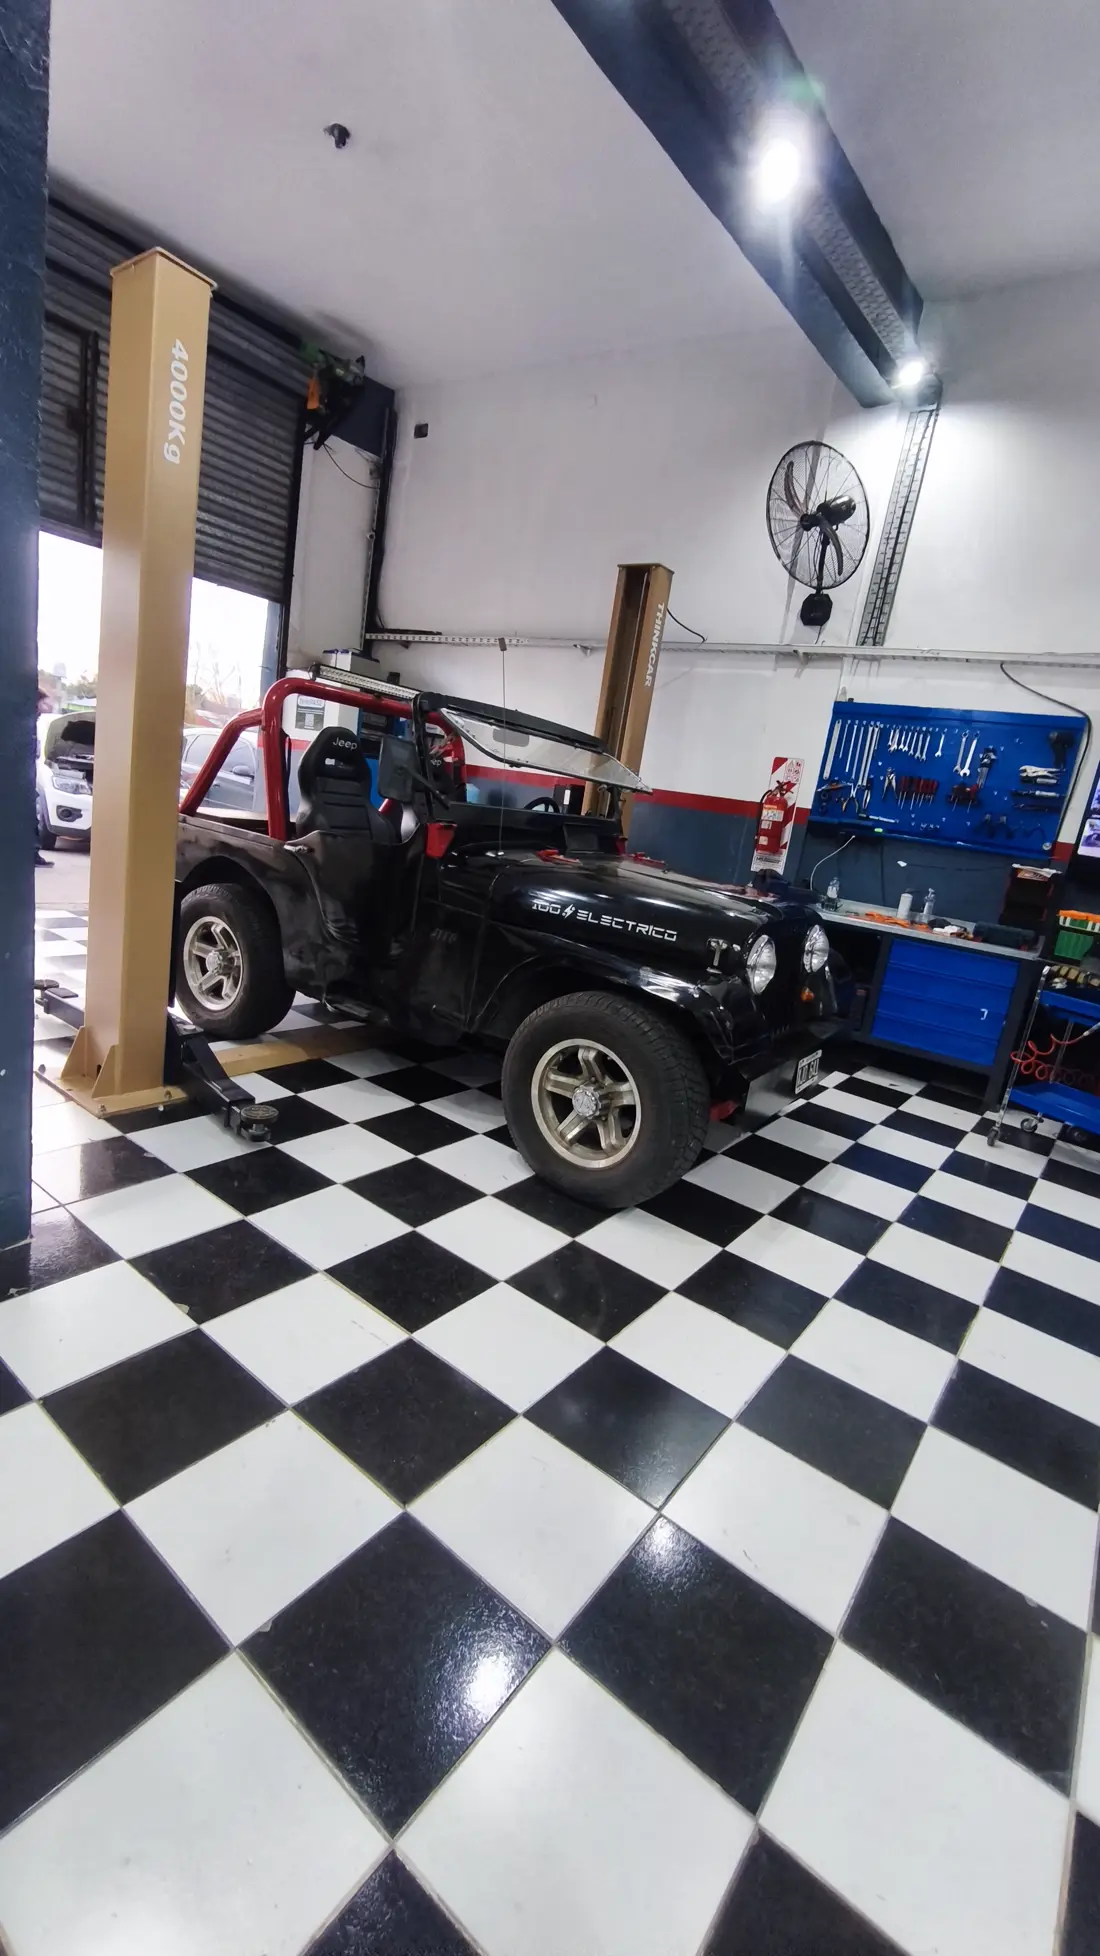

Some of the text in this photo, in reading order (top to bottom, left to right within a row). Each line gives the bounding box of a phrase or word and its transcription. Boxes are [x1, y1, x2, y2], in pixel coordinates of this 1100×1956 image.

[163, 339, 188, 464] 4000Kg
[644, 602, 665, 687] THINKCAR
[332, 736, 358, 751] Jeep
[576, 909, 677, 942] ELECTRICO
